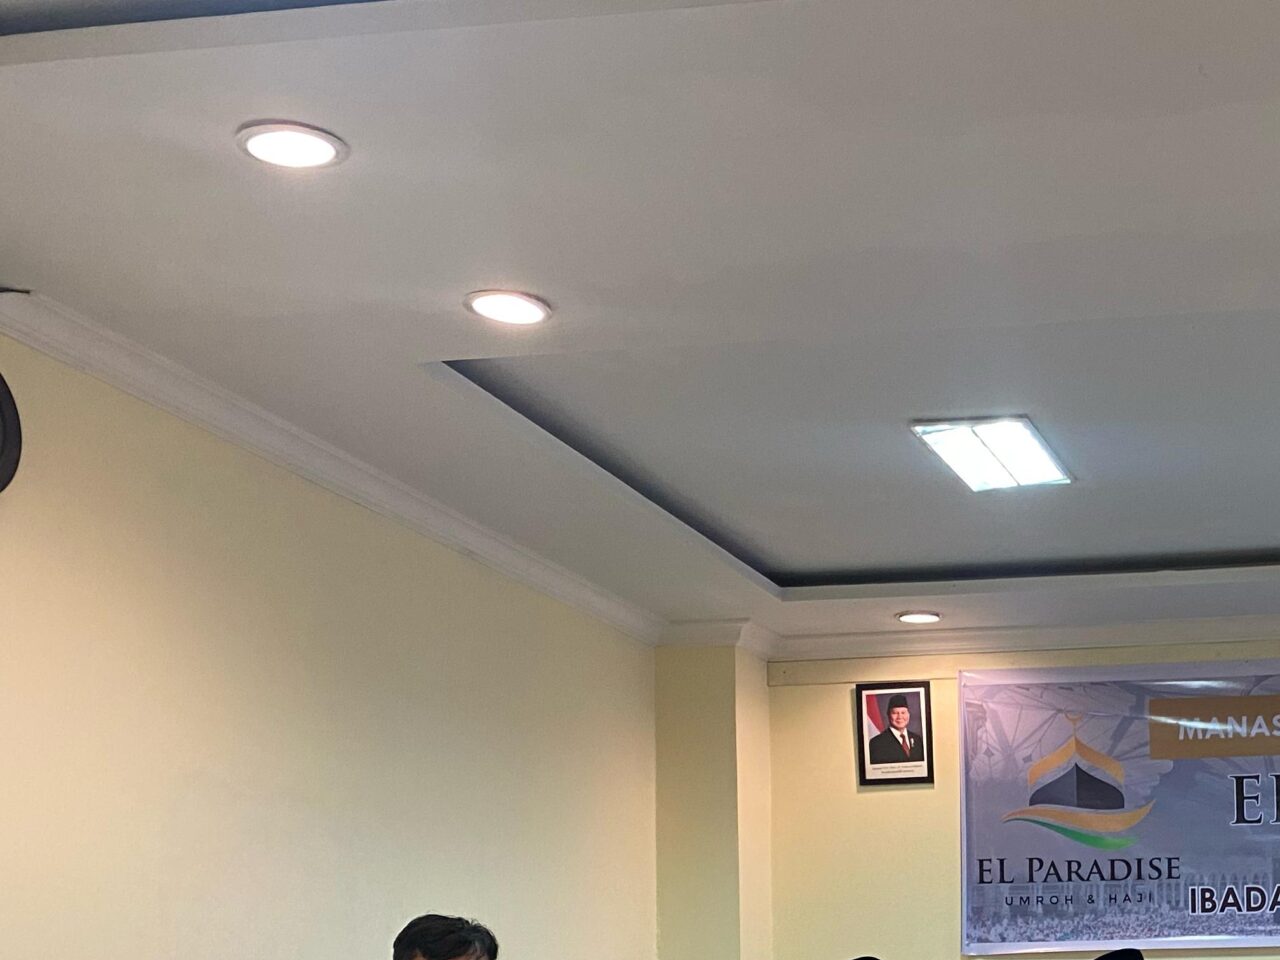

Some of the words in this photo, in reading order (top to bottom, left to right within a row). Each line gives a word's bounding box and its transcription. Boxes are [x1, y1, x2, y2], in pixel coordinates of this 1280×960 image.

[976, 857, 1015, 885] EL
[1025, 855, 1181, 884] PARADISE
[1004, 894, 1074, 907] UMROH
[1086, 893, 1095, 905] &
[1108, 891, 1153, 904] HAJI
